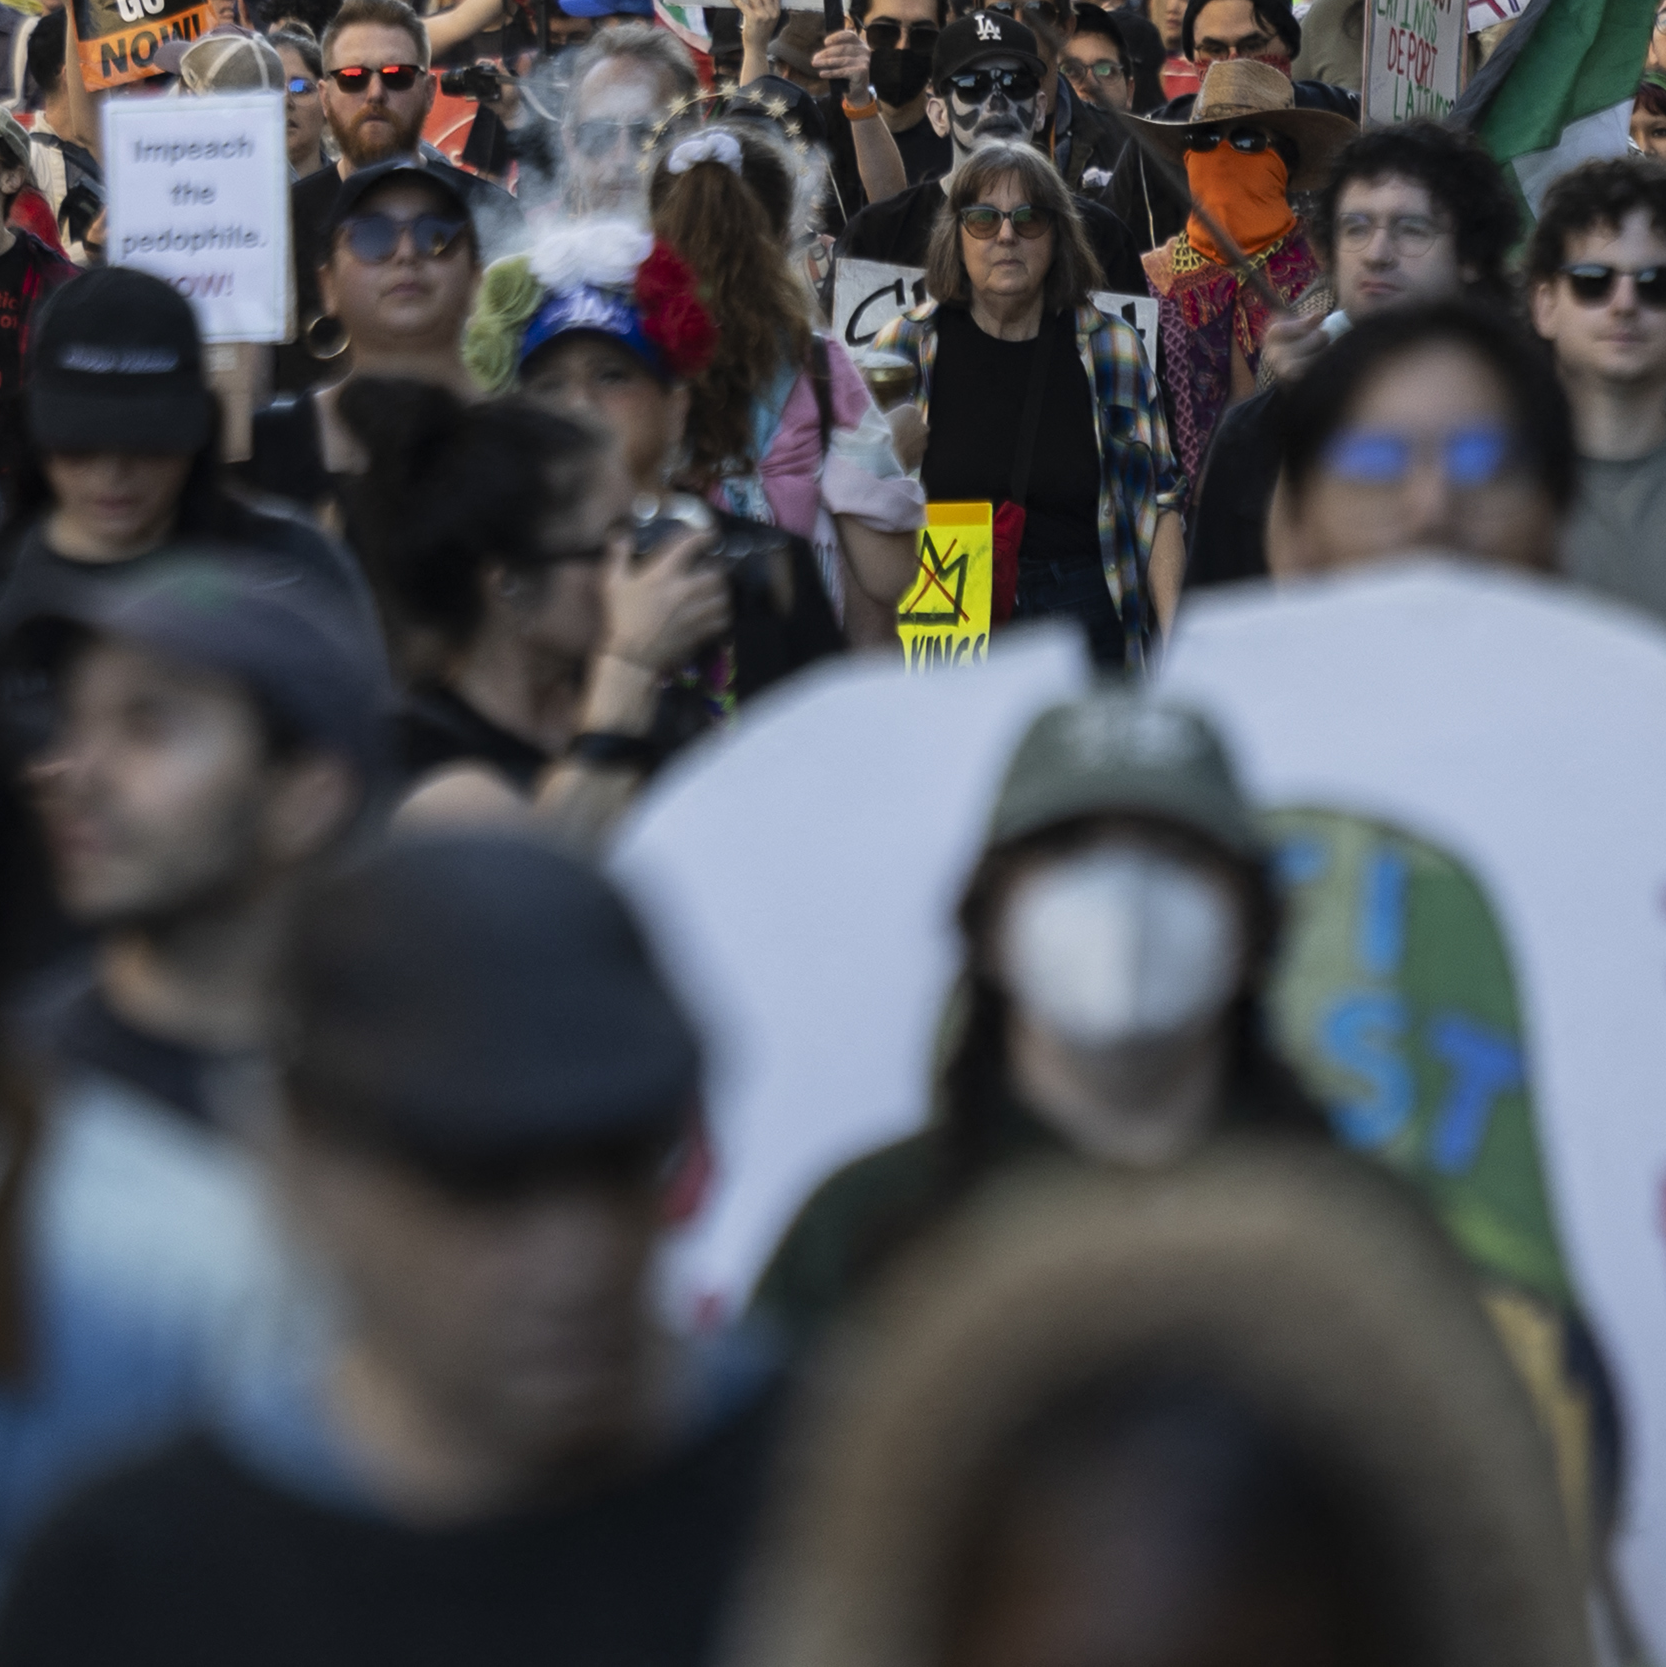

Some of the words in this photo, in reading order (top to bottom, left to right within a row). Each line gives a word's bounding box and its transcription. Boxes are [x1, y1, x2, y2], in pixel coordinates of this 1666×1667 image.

[973, 14, 1003, 41] LA
[1387, 26, 1438, 89] DEPORT
[132, 136, 255, 166] Impeach
[169, 183, 217, 207] the
[122, 225, 268, 259] pedophile.
[167, 271, 234, 298] OW!
